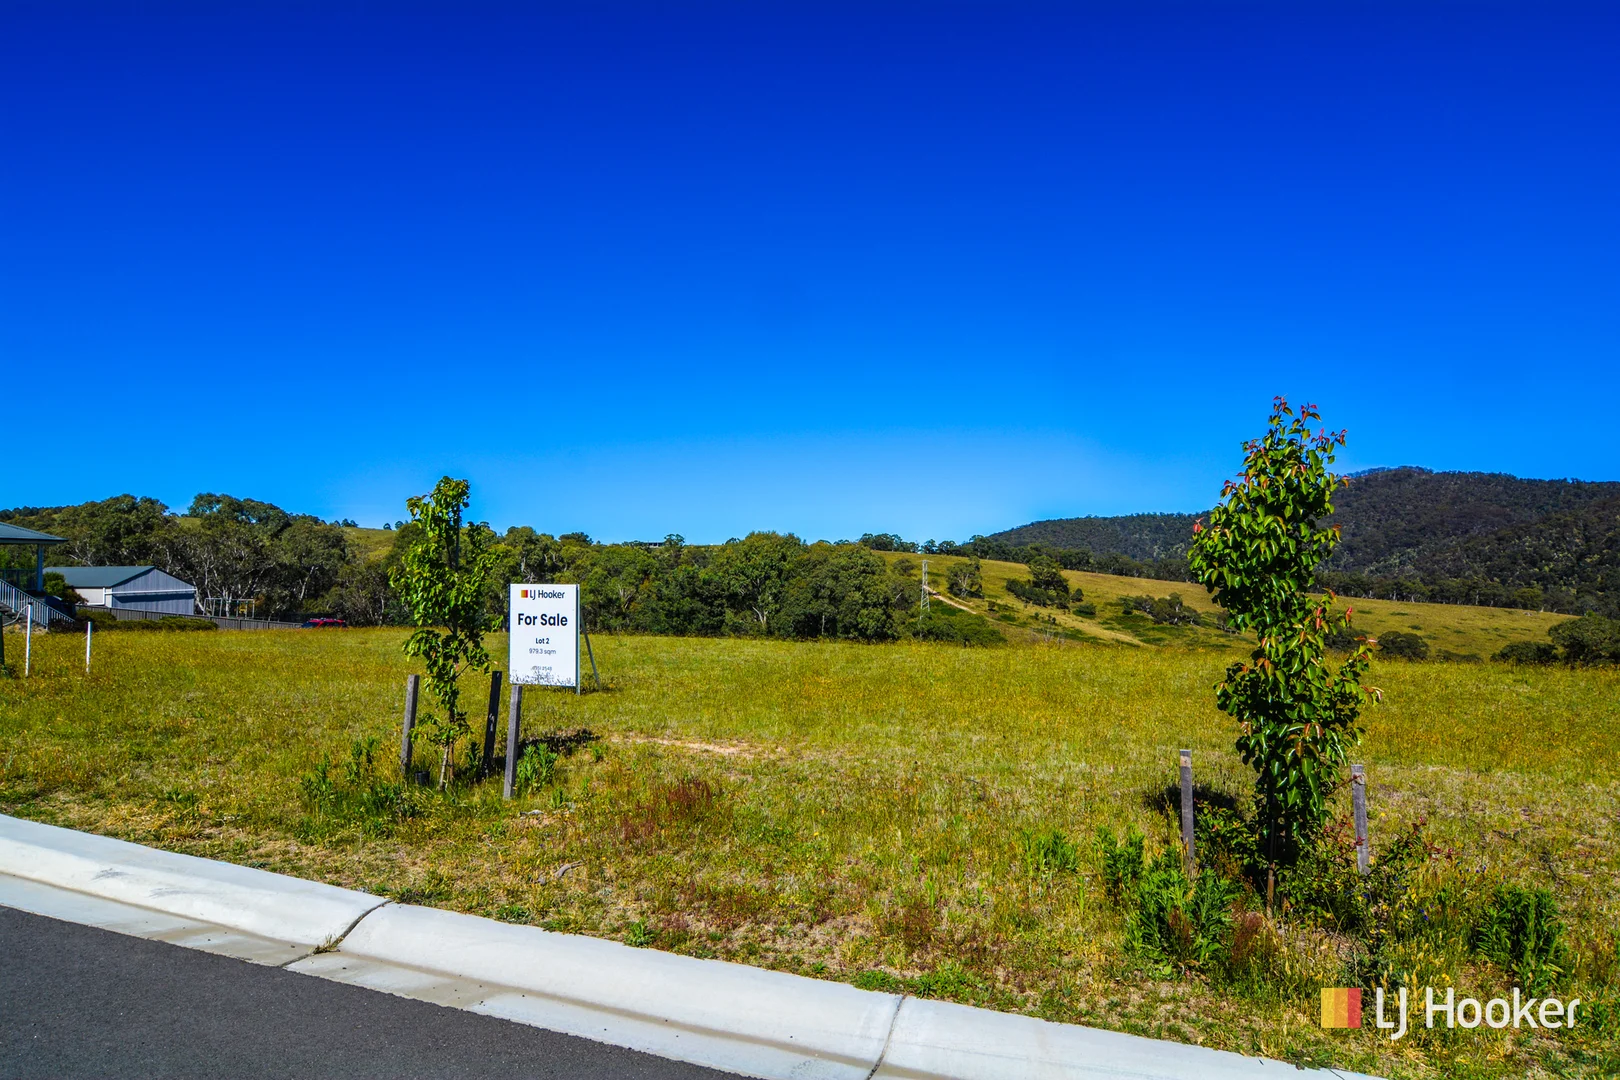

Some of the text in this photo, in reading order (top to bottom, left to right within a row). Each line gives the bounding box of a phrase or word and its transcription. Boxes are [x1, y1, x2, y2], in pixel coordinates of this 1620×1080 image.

[530, 590, 565, 600] LJ Hooker
[518, 613, 568, 626] For Sale
